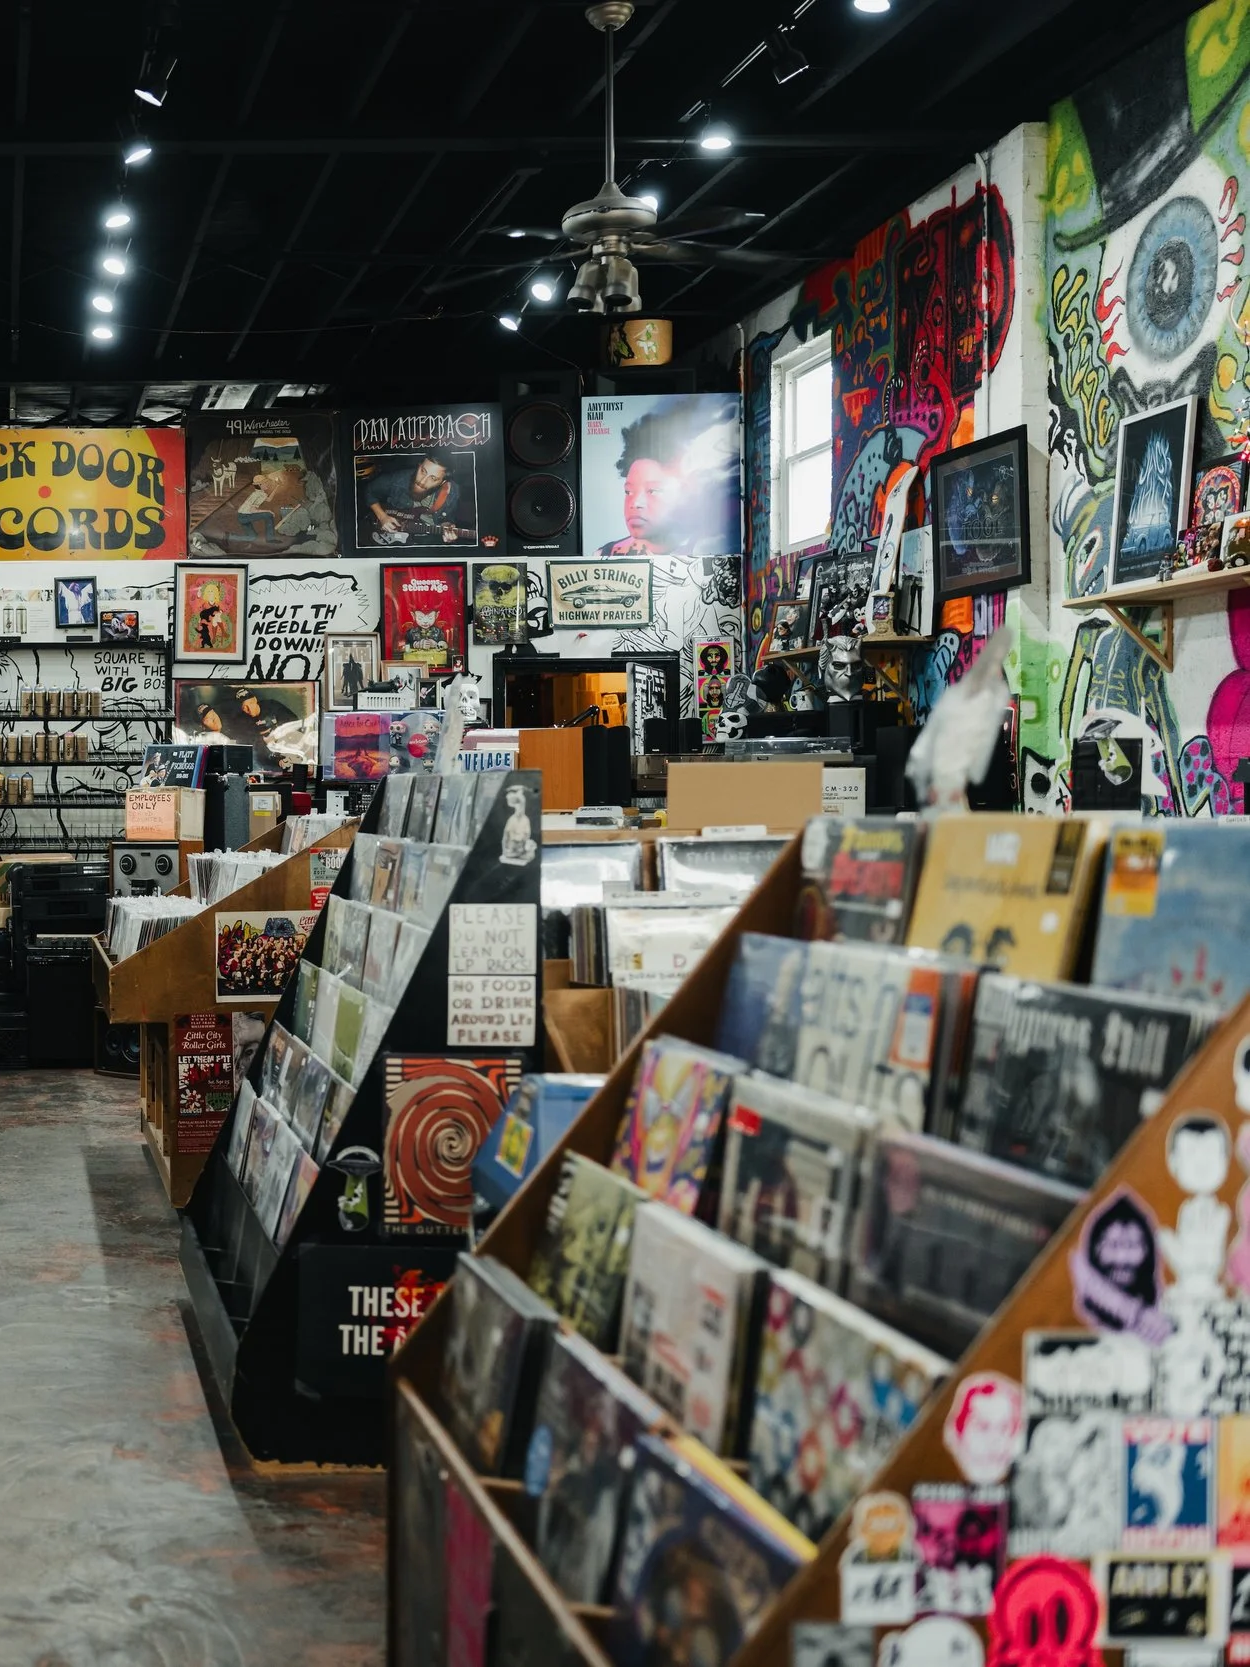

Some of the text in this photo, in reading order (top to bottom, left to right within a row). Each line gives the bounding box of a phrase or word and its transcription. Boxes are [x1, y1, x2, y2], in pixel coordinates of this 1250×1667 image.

[226, 419, 290, 434] 49 Winchester
[355, 413, 491, 447] DAN AUERBACH
[52, 441, 165, 506] DOOR
[557, 568, 643, 589] BILLY STRINGS
[430, 584, 448, 593] Age
[559, 611, 643, 620] HIGHWAY PRAYERS
[252, 620, 328, 635] NEEDLE
[94, 651, 145, 664] SQUARE
[95, 665, 166, 676] WITH THE
[101, 676, 138, 693] BIG
[129, 794, 171, 802] EMPLOYEES
[132, 802, 156, 810] ONLY
[452, 907, 526, 925] PLEASE
[454, 929, 523, 944] DO NOT
[453, 947, 525, 959] LEAN ON
[455, 960, 474, 972] LP
[453, 980, 531, 992] NO FOOD
[452, 996, 532, 1009] OR DRINK
[451, 1013, 505, 1025] AROUND
[184, 1031, 222, 1041] Little City
[457, 1029, 521, 1043] PLEASE
[182, 1041, 226, 1050] Roller Girls
[384, 1225, 403, 1234] THE
[348, 1286, 425, 1318] THESE
[338, 1324, 385, 1356] THE
